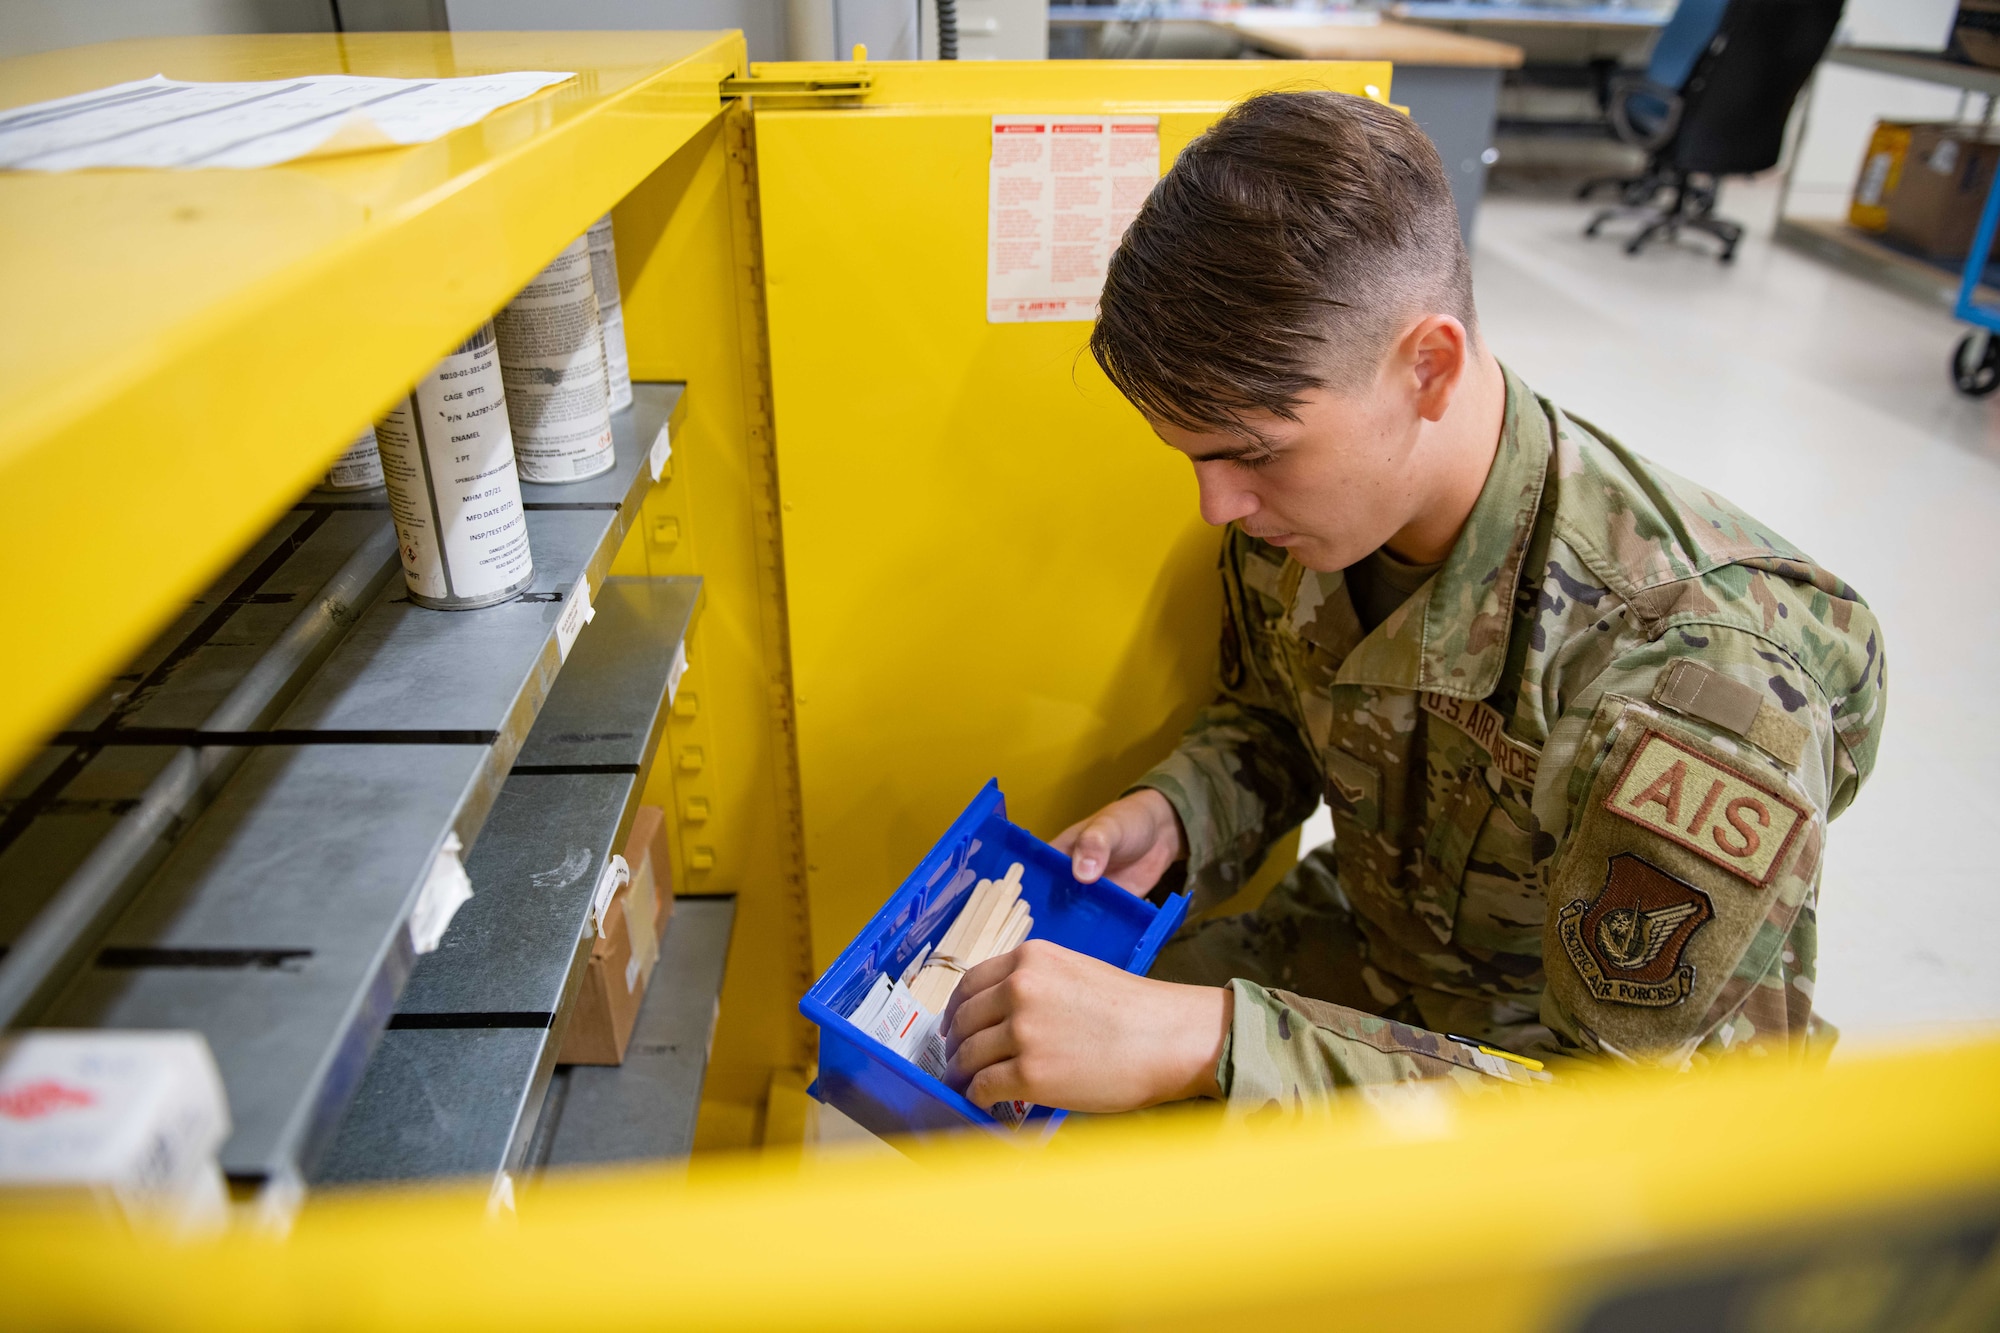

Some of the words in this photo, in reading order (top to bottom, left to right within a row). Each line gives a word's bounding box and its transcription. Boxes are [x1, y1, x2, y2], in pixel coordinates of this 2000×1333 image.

[443, 392, 463, 402] CAGE
[447, 413, 462, 423] P/N
[451, 431, 480, 443] ENAMEL
[461, 454, 470, 462] PT
[462, 493, 482, 503] MHM
[466, 511, 482, 522] MFD
[483, 507, 500, 518] DATE
[469, 527, 503, 541] INSP/TEST
[502, 519, 515, 531] DATE
[1465, 703, 1496, 746] AIR
[1491, 724, 1537, 785] RCE
[1629, 759, 1770, 858] AIS
[1564, 922, 1594, 973] PACIFIC
[1587, 974, 1613, 997] AIR
[1619, 984, 1676, 1001] FORCES
